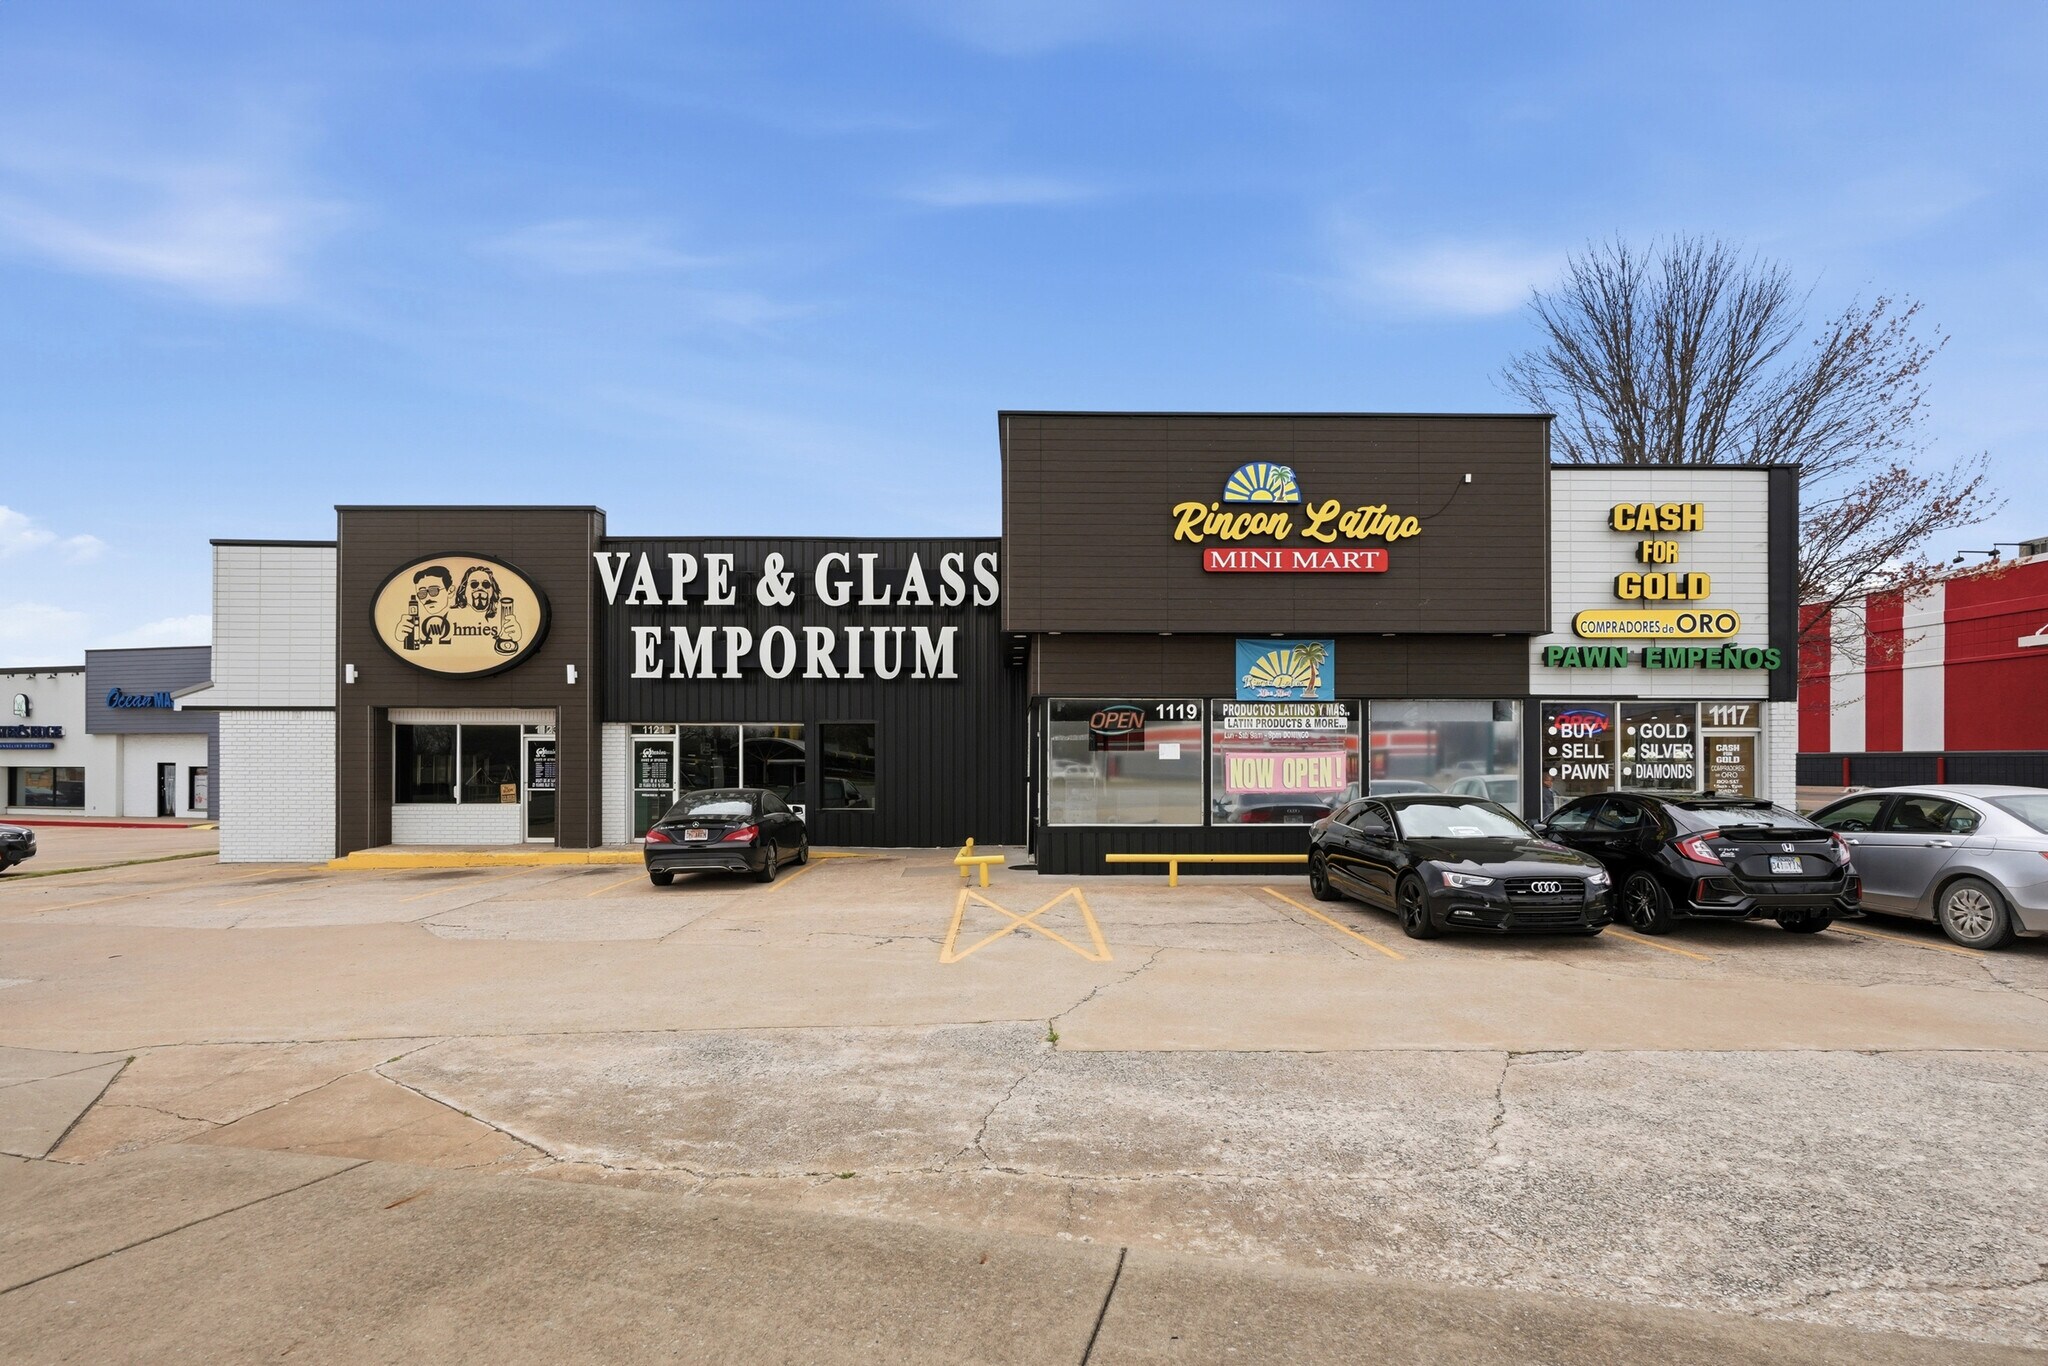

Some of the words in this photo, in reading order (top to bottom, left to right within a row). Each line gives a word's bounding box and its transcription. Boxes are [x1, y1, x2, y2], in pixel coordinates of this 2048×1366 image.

[1172, 501, 1293, 543] Rincon
[1301, 499, 1422, 543] Latino
[1612, 503, 1704, 531] CASH
[1210, 551, 1283, 568] MINI
[1292, 551, 1380, 568] MART
[1641, 540, 1680, 563] FOR
[593, 551, 737, 606] VAPE
[756, 551, 796, 607] &
[815, 551, 1000, 607] GLASS
[1617, 572, 1711, 600] GOLD
[1580, 620, 1660, 634] COMPRADORES
[1662, 622, 1675, 634] de
[1676, 613, 1737, 634] ORO
[630, 625, 959, 680] EMPORIUM
[1547, 645, 1629, 669] PAWN
[1649, 642, 1782, 670] EMPEÑOS
[106, 687, 152, 709] Ocean
[1156, 703, 1197, 720] 1119
[1222, 703, 1276, 716] PRODUCTOS
[1278, 703, 1315, 716] LATINOS
[1317, 703, 1325, 716] Y
[1709, 705, 1750, 726] 1117
[1090, 711, 1145, 729] OPEN
[1227, 719, 1254, 728] LATIN
[1255, 719, 1303, 728] PRODUCTS
[1305, 719, 1312, 728] &
[1554, 714, 1610, 731] OPEN
[642, 725, 665, 734] 1121
[1561, 723, 1596, 739] BUY
[1640, 723, 1688, 739] GOLD
[1561, 743, 1605, 759] SELL
[1640, 743, 1694, 759] SILVER
[1715, 744, 1740, 752] CASH
[1715, 756, 1740, 764] GOLD
[1230, 757, 1275, 789] NOW
[1561, 764, 1609, 780] PAWN
[1636, 763, 1693, 779] DIAMONDS
